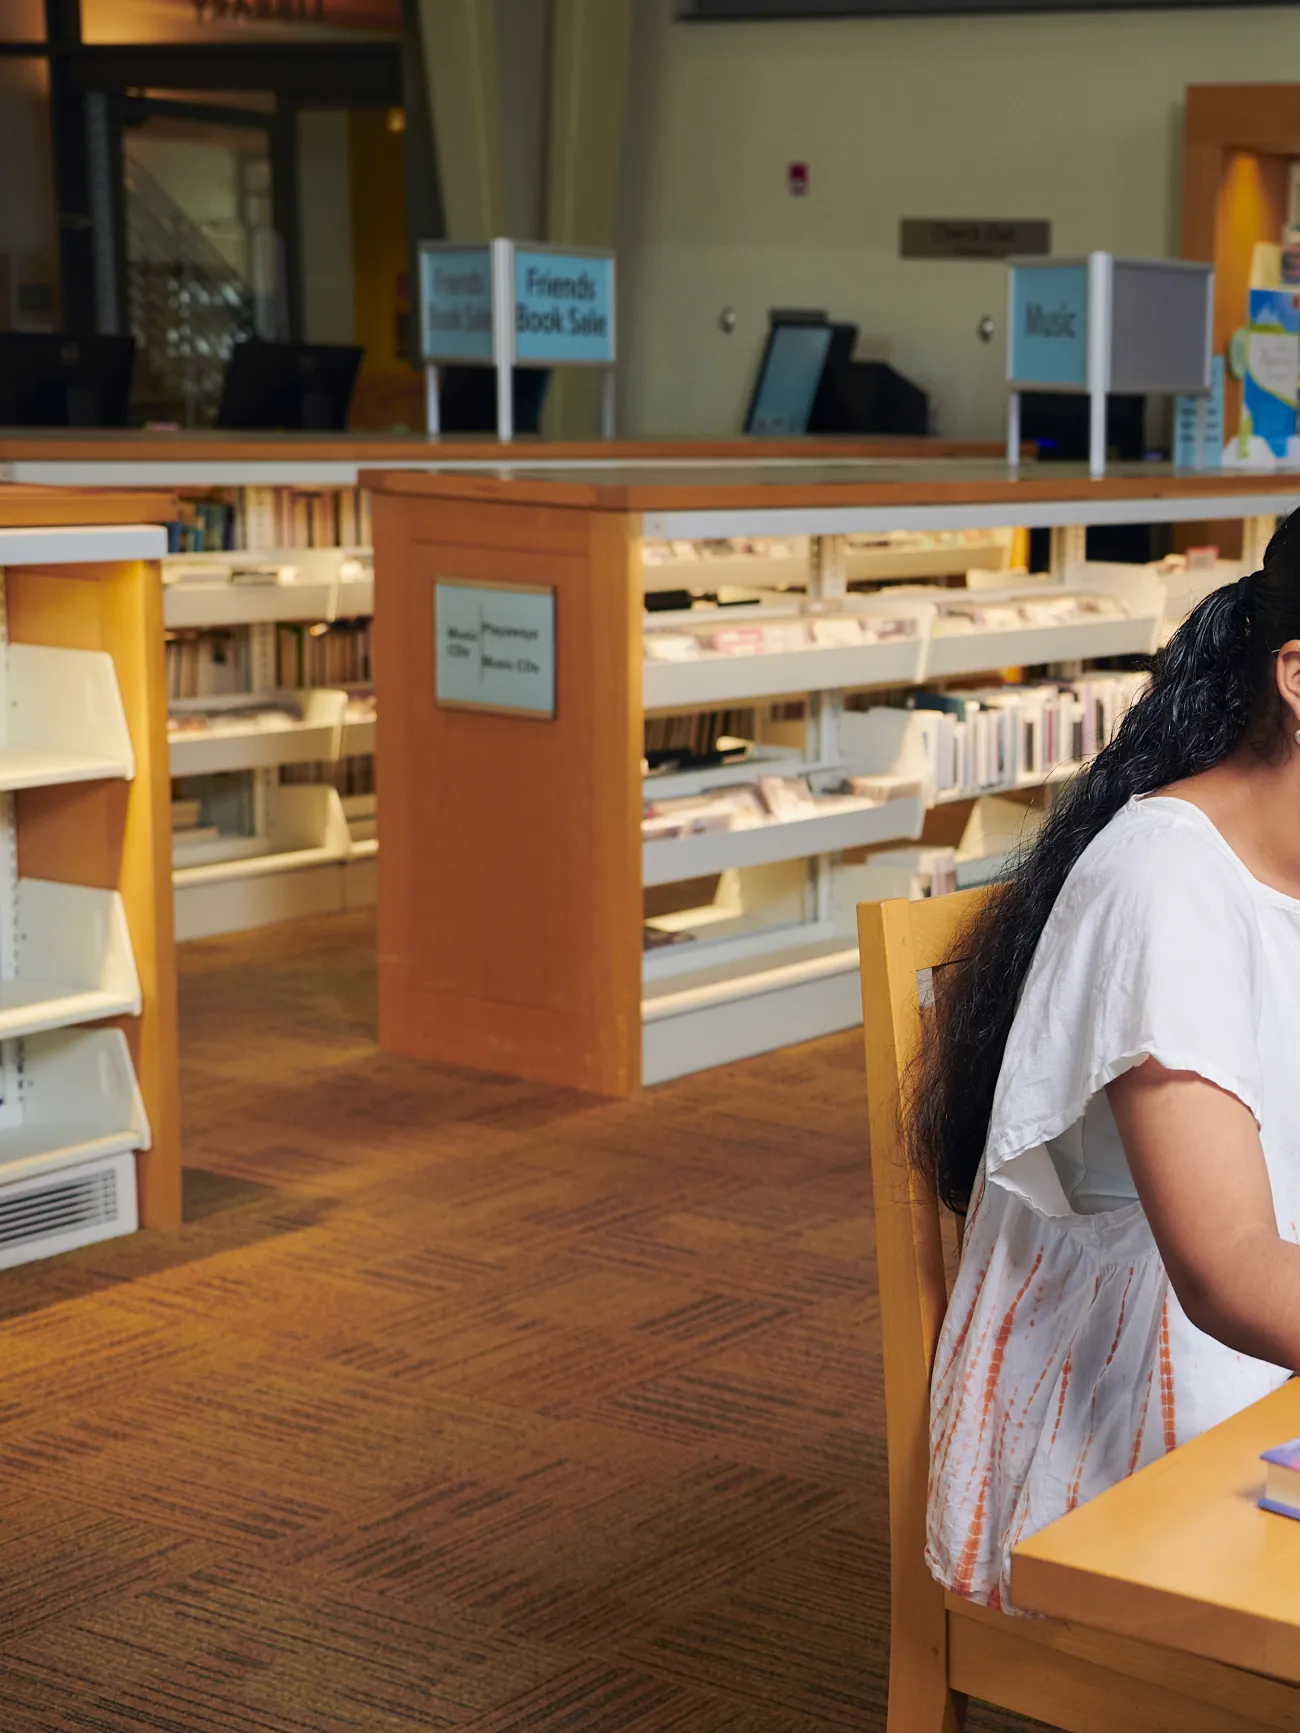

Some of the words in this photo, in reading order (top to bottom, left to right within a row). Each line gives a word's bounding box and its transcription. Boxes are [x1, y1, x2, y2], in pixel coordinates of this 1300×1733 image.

[526, 266, 597, 301] Friends
[516, 303, 564, 335] Book
[568, 305, 607, 337] Sale
[1025, 302, 1076, 339] Music
